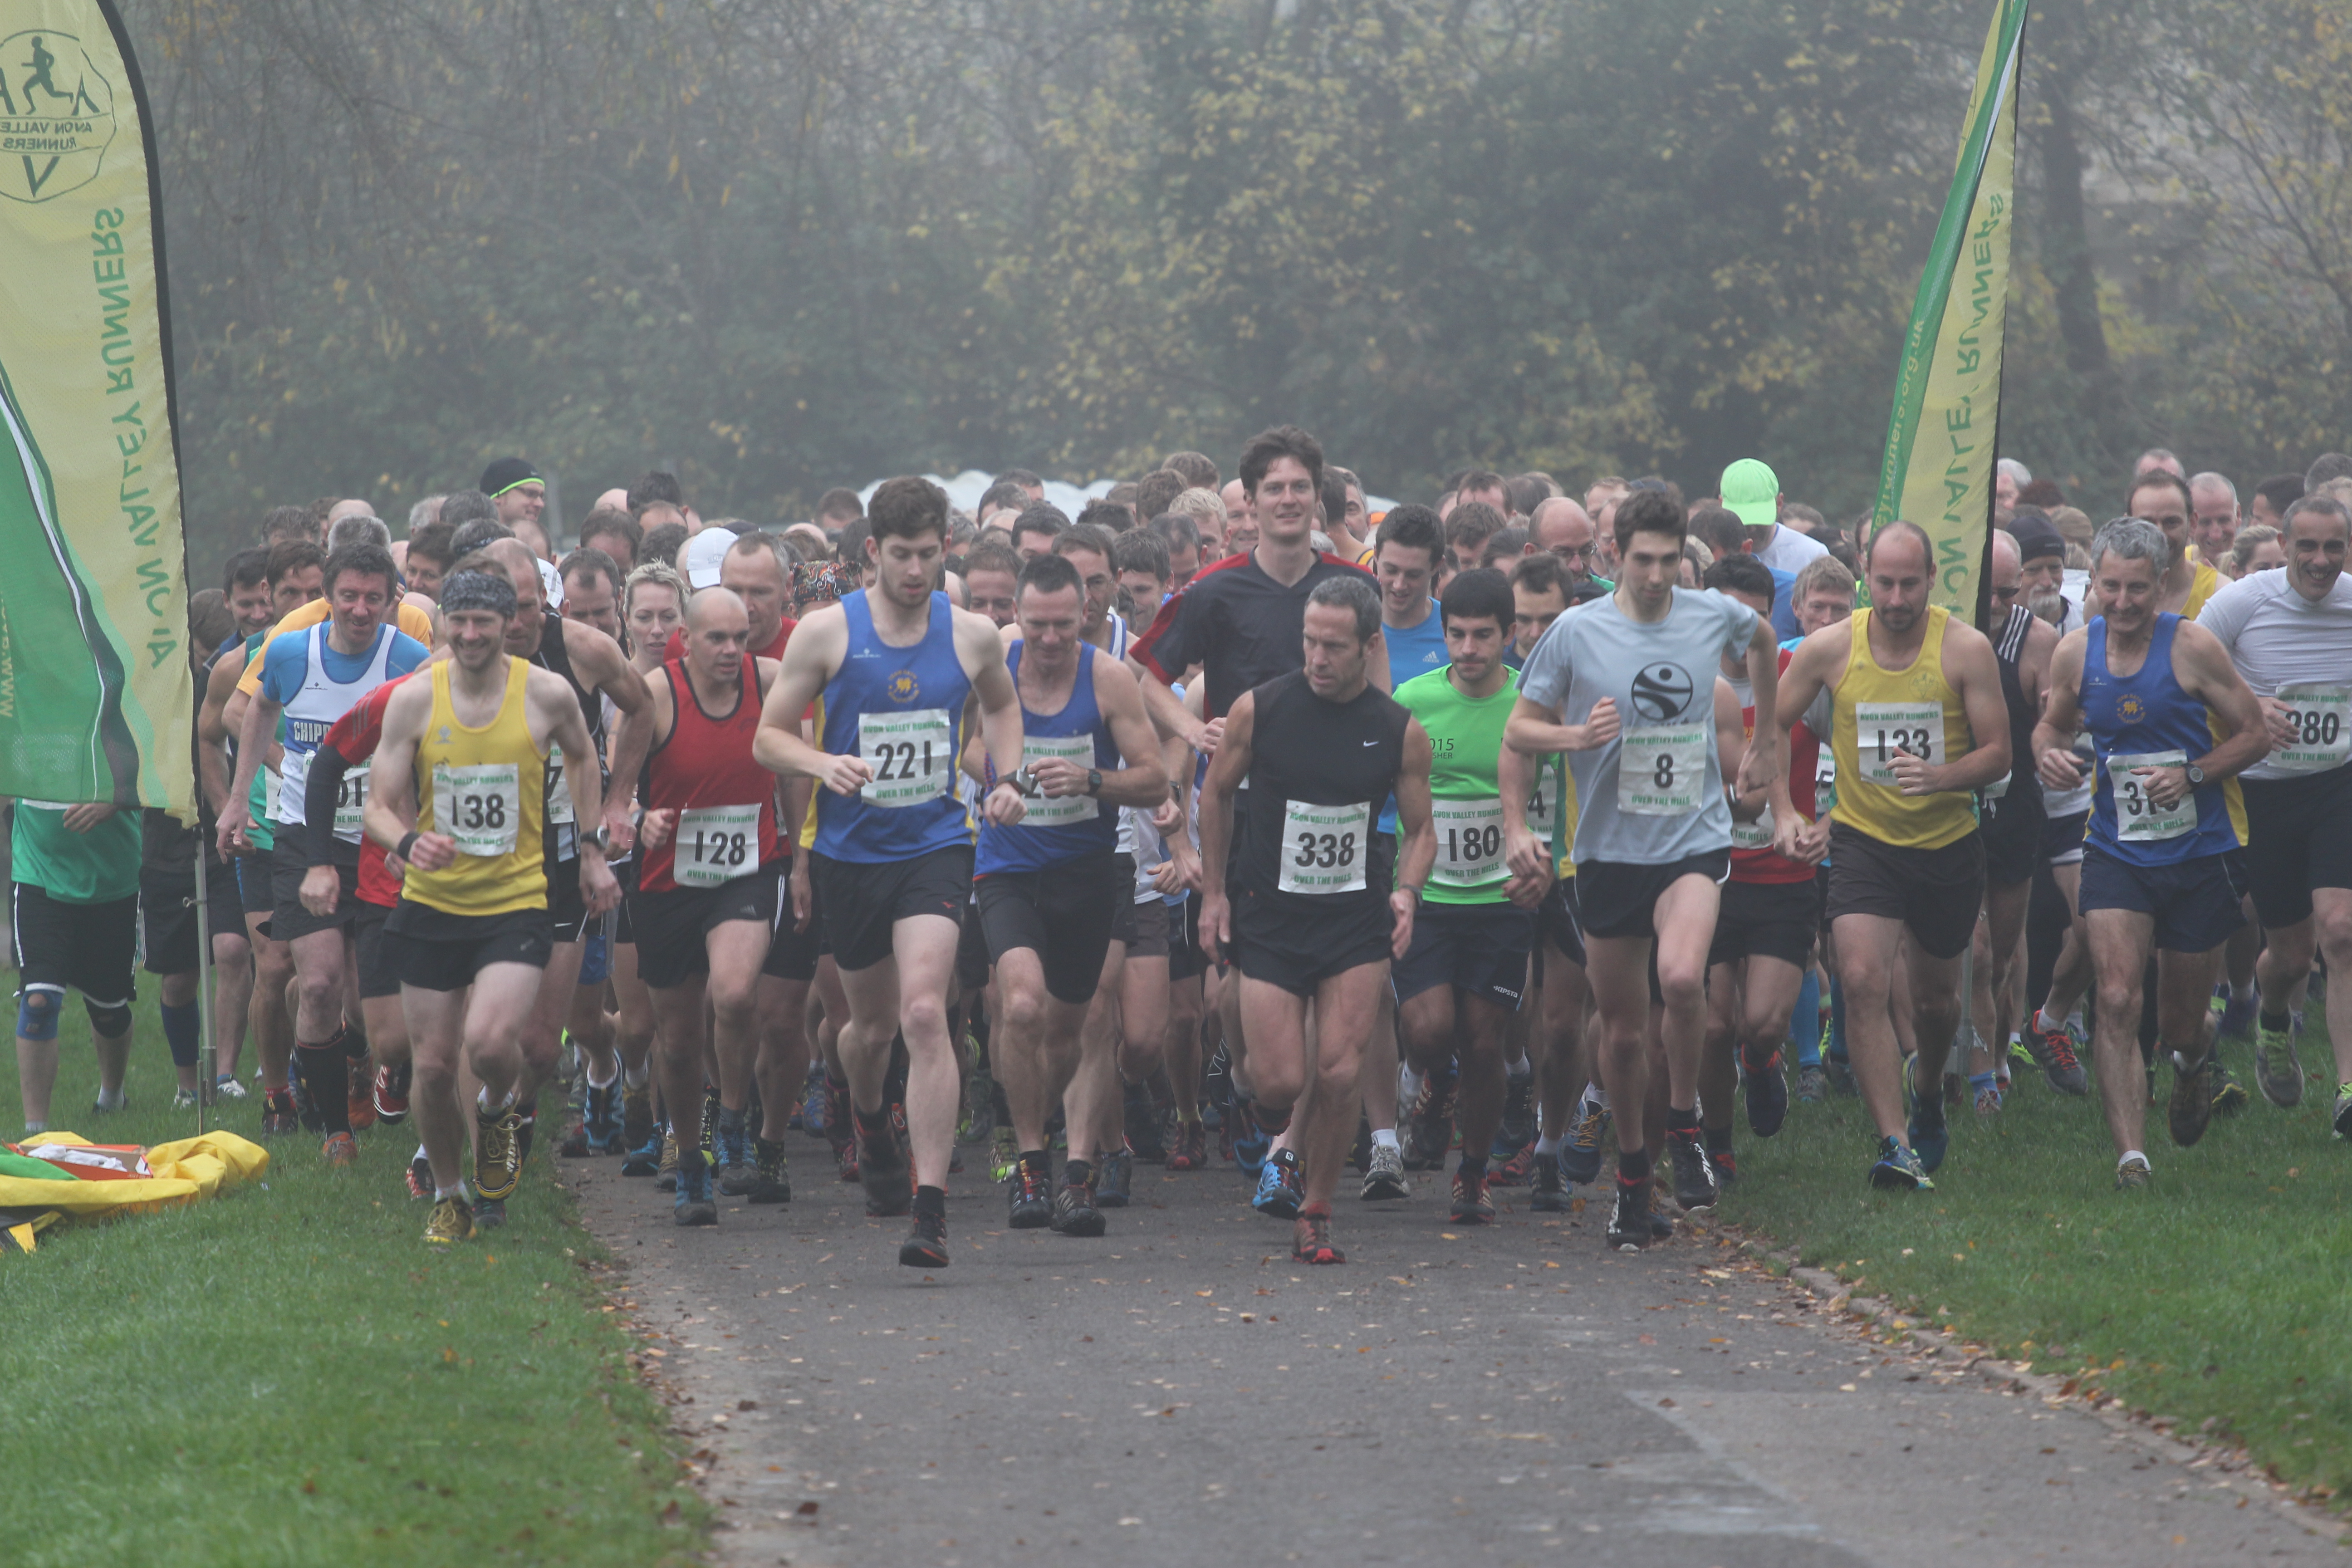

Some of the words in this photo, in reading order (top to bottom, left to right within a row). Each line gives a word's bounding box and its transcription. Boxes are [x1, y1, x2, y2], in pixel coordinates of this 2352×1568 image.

[1881, 712, 1904, 720] VALLEY
[1906, 710, 1939, 720] RUNNERS
[2285, 710, 2340, 745] 280
[1878, 728, 1931, 762] 133
[875, 740, 931, 781] 221
[2303, 752, 2314, 761] THE
[1654, 753, 1674, 788] 8
[1872, 769, 1892, 778] OVER
[900, 787, 913, 798] THE
[452, 793, 505, 829] 138
[1433, 810, 1450, 819] AVON
[1452, 811, 1476, 819] VALLEY
[1310, 815, 1335, 824] VALLEY
[694, 831, 746, 866] 128
[1295, 832, 1355, 868] 338
[1449, 825, 1500, 862] 180
[687, 869, 707, 879] OVER
[709, 871, 722, 881] THE
[1445, 869, 1465, 877] OVER
[1466, 867, 1480, 877] THE
[1481, 862, 1499, 873] HILLS
[1294, 875, 1315, 884] OVER
[1317, 876, 1331, 884] THE
[1333, 873, 1352, 884] HILLS
